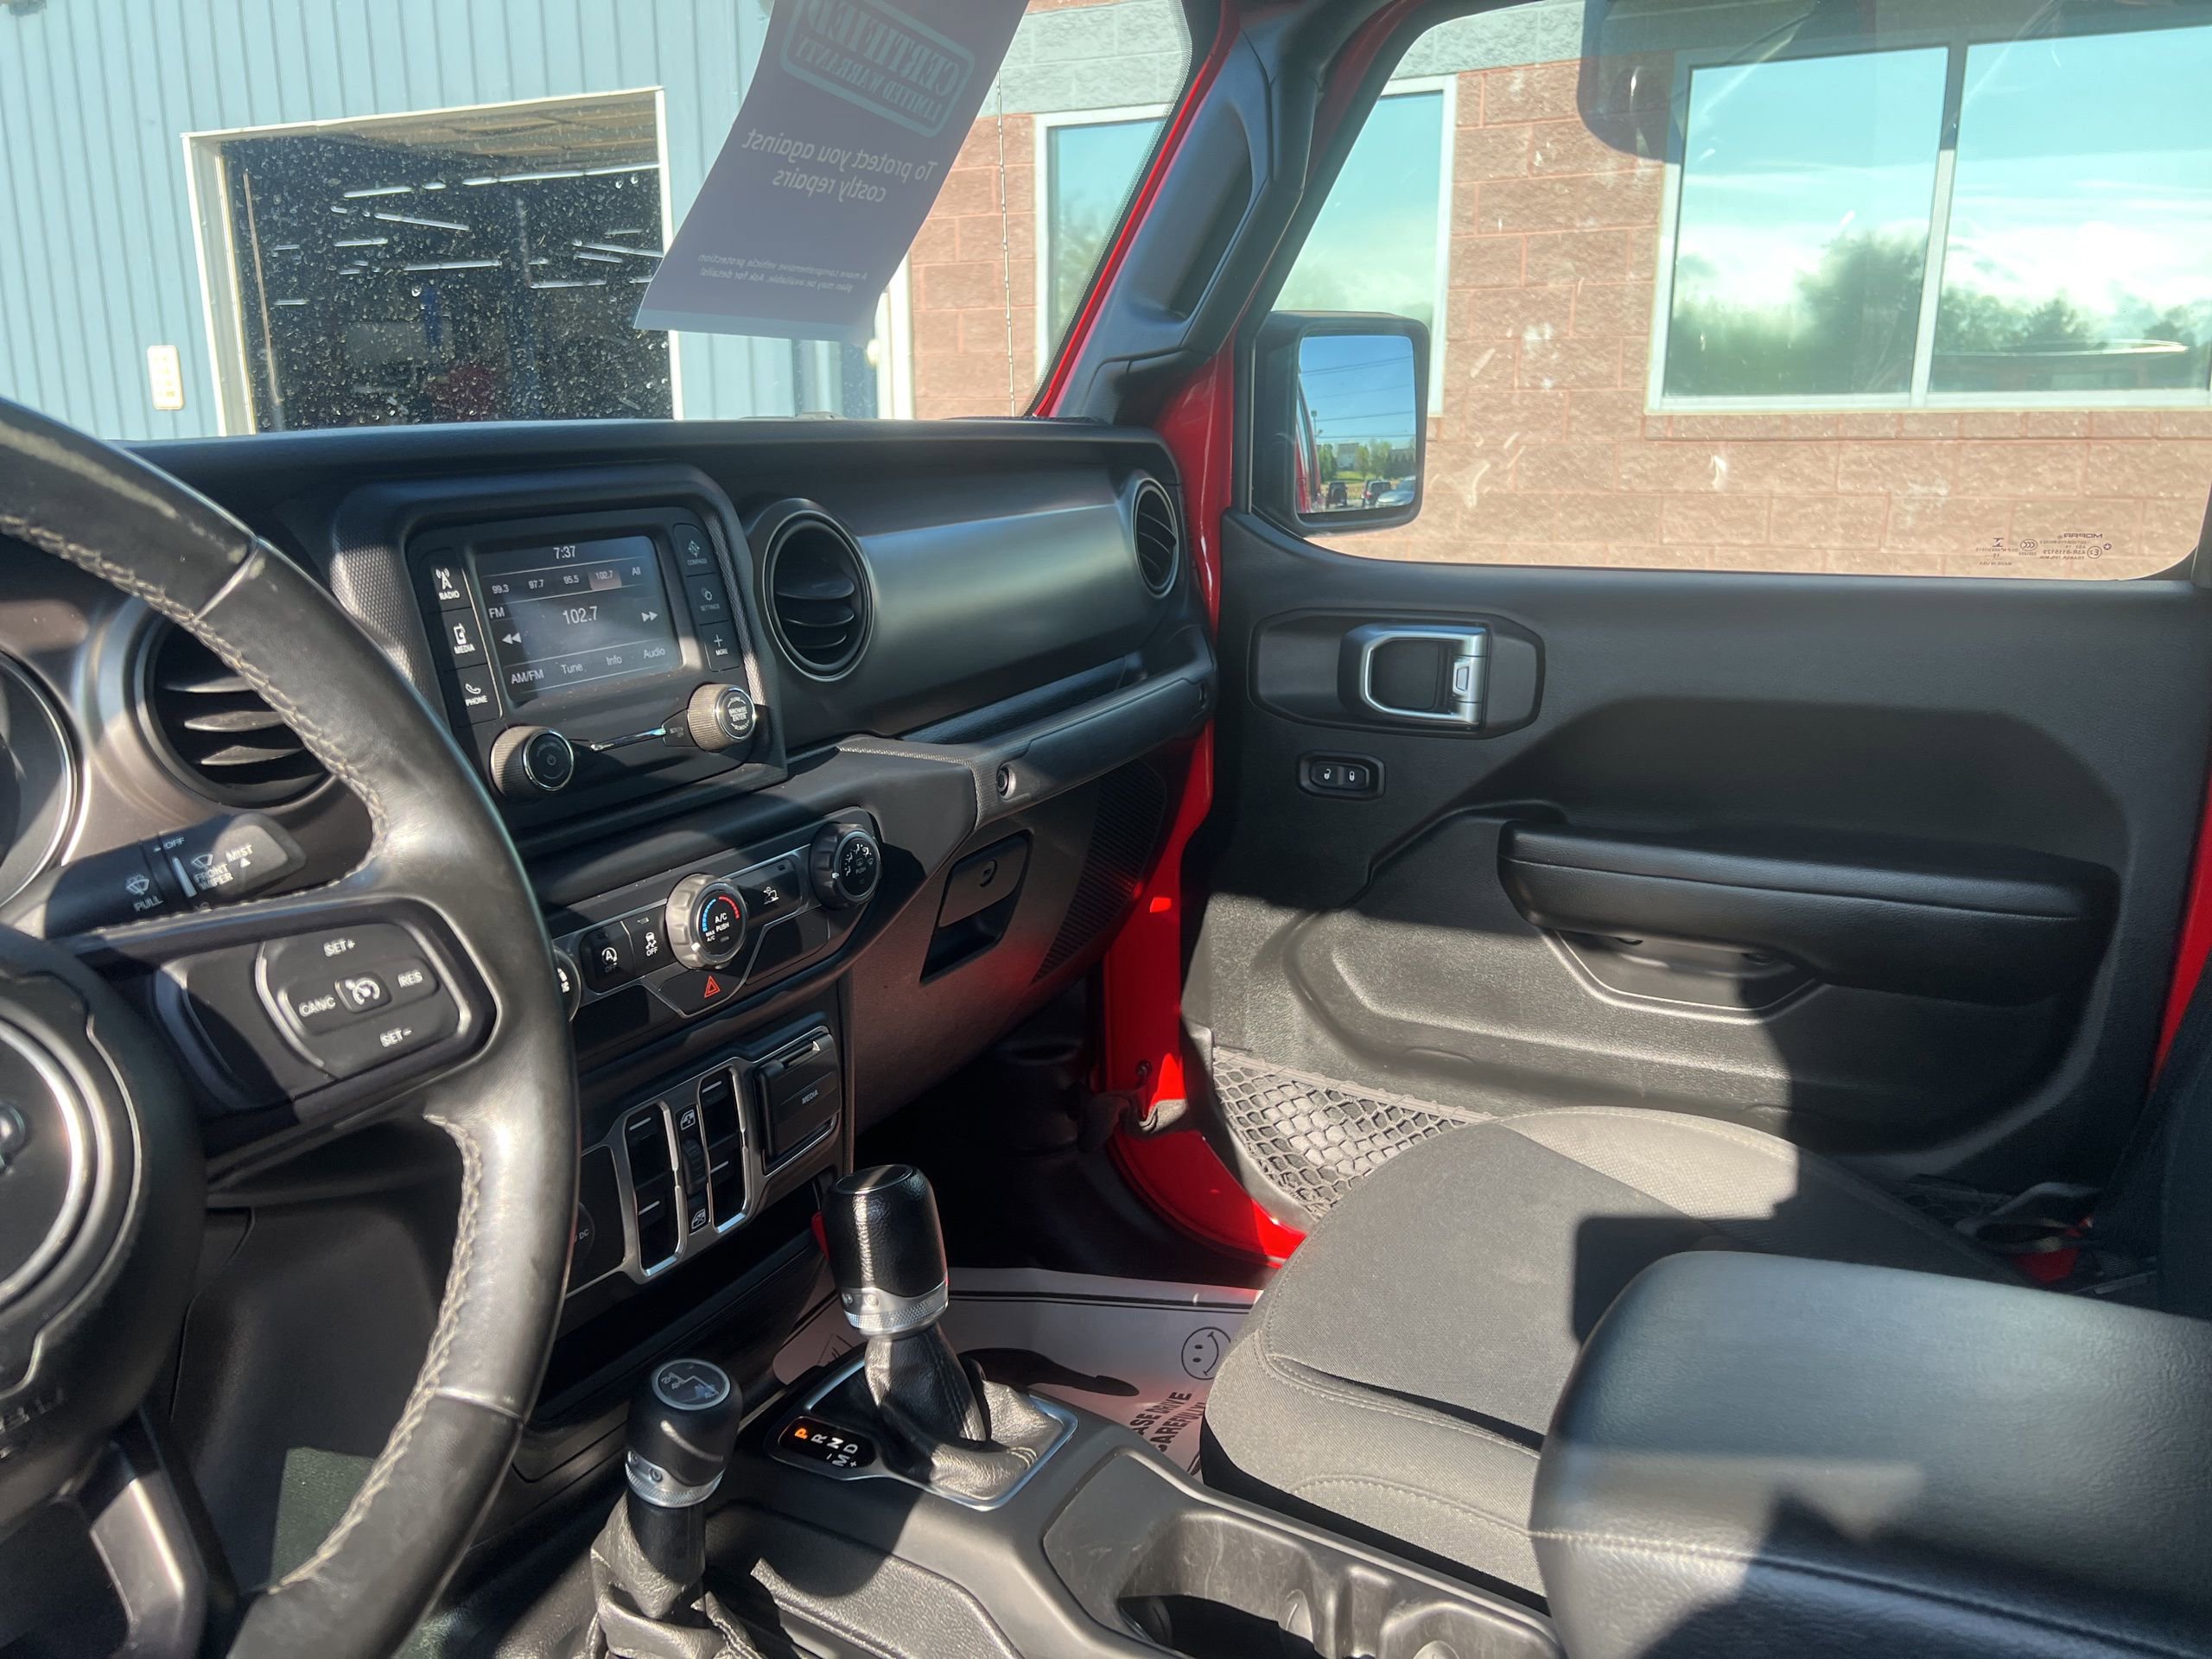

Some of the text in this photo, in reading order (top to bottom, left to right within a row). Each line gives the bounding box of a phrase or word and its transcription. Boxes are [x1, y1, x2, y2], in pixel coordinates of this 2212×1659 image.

[553, 545, 577, 559] 7:37
[594, 569, 614, 581] 102.7
[631, 566, 642, 576] All
[528, 579, 544, 589] 97.7
[563, 575, 580, 585] 95.5
[438, 589, 461, 601] RADIO
[491, 584, 510, 594] 99.3
[487, 607, 505, 620] FM
[562, 606, 599, 626] 102.7
[454, 643, 476, 655] MEDIA
[643, 647, 666, 659] Audio
[715, 647, 729, 657] MORE
[606, 654, 623, 666] Info
[560, 662, 584, 675] Tune
[510, 669, 545, 685] AM/FM
[465, 694, 489, 707] PHONE
[163, 836, 187, 850] OFF
[225, 843, 253, 863] MIST
[193, 862, 229, 884] FRONT
[196, 870, 235, 892] WIPER
[132, 894, 164, 912] PULL
[715, 912, 728, 924] A/C
[715, 921, 730, 932] PUSH
[323, 937, 356, 957] SET+
[645, 946, 658, 957] OFF
[397, 969, 423, 988] RES
[298, 995, 336, 1017] CANC
[801, 1089, 819, 1104] MEDIA
[579, 1229, 589, 1240] DC
[1144, 1391, 1192, 1414] DRIVE
[794, 1427, 858, 1455] P R N D
[831, 1453, 851, 1467] M
